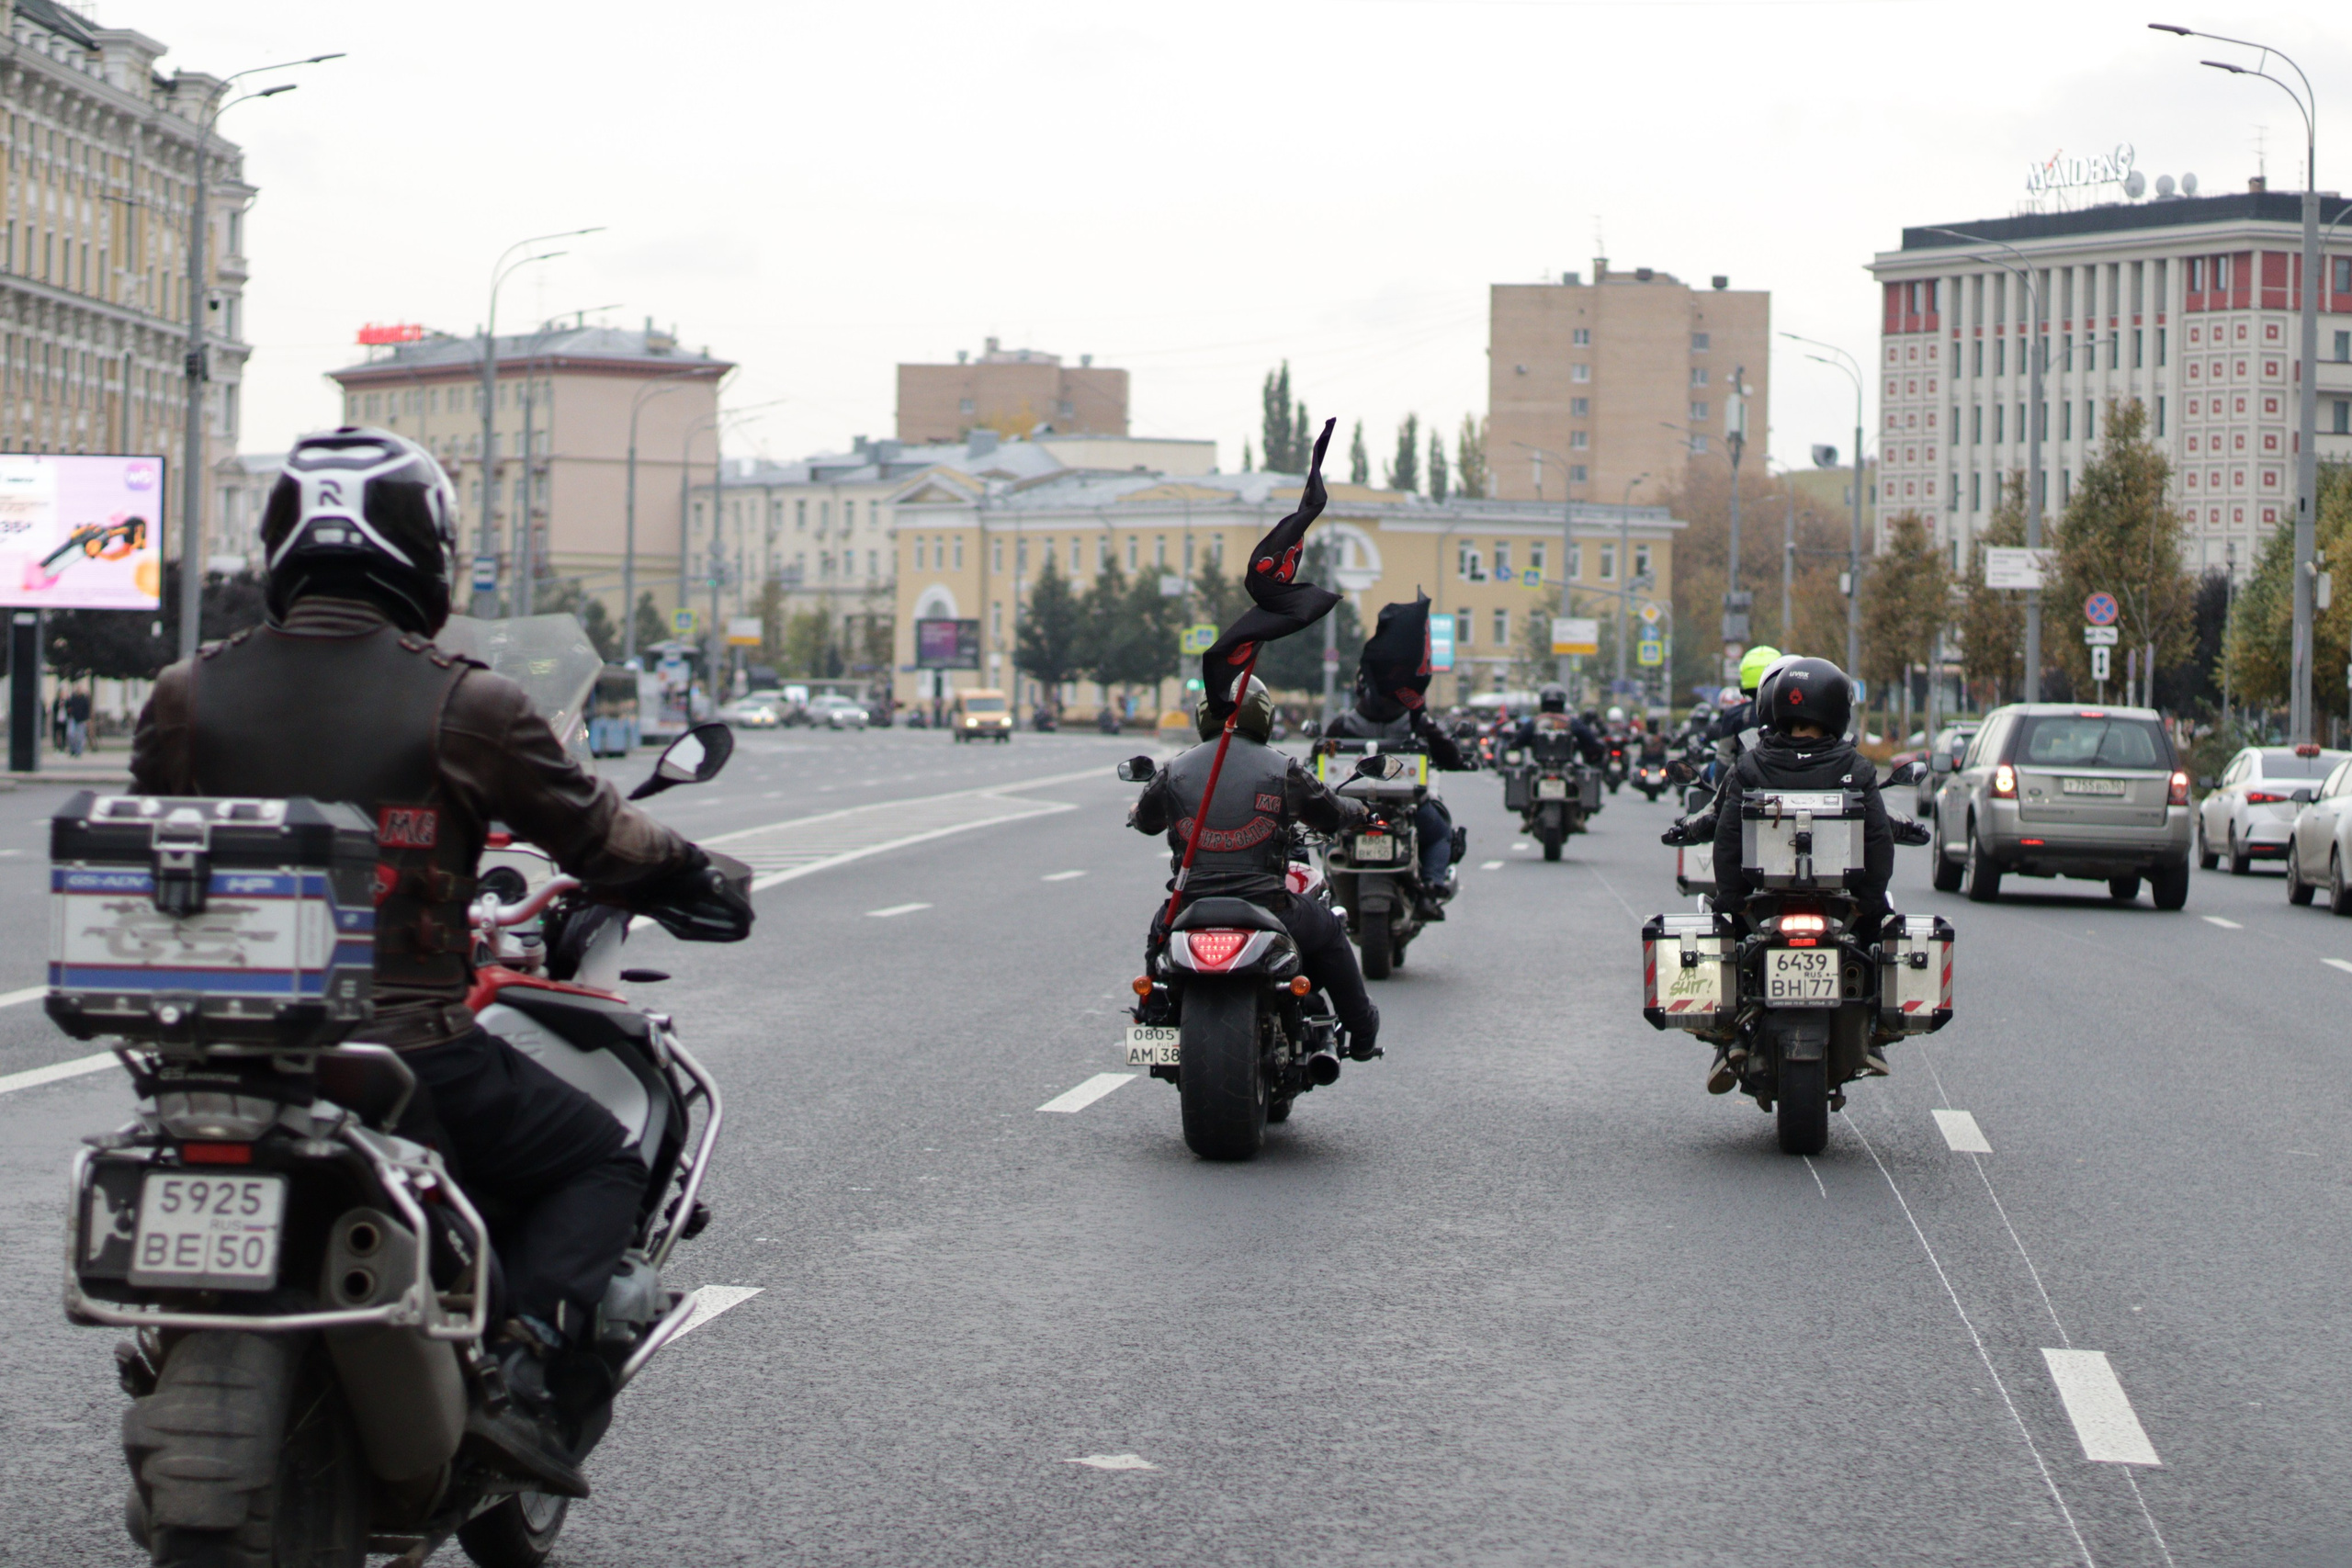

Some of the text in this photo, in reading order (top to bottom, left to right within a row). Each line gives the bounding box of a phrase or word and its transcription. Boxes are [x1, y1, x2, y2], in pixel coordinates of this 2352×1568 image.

[2026, 143, 2134, 191] MAIDENS
[1777, 953, 1827, 971] 6439
[1809, 979, 1834, 997] 77
[1134, 1029, 1175, 1041] 0805
[1160, 1048, 1181, 1062] 38
[160, 1180, 263, 1215] 5925
[209, 1218, 243, 1231] RUS
[215, 1234, 265, 1269] 50
